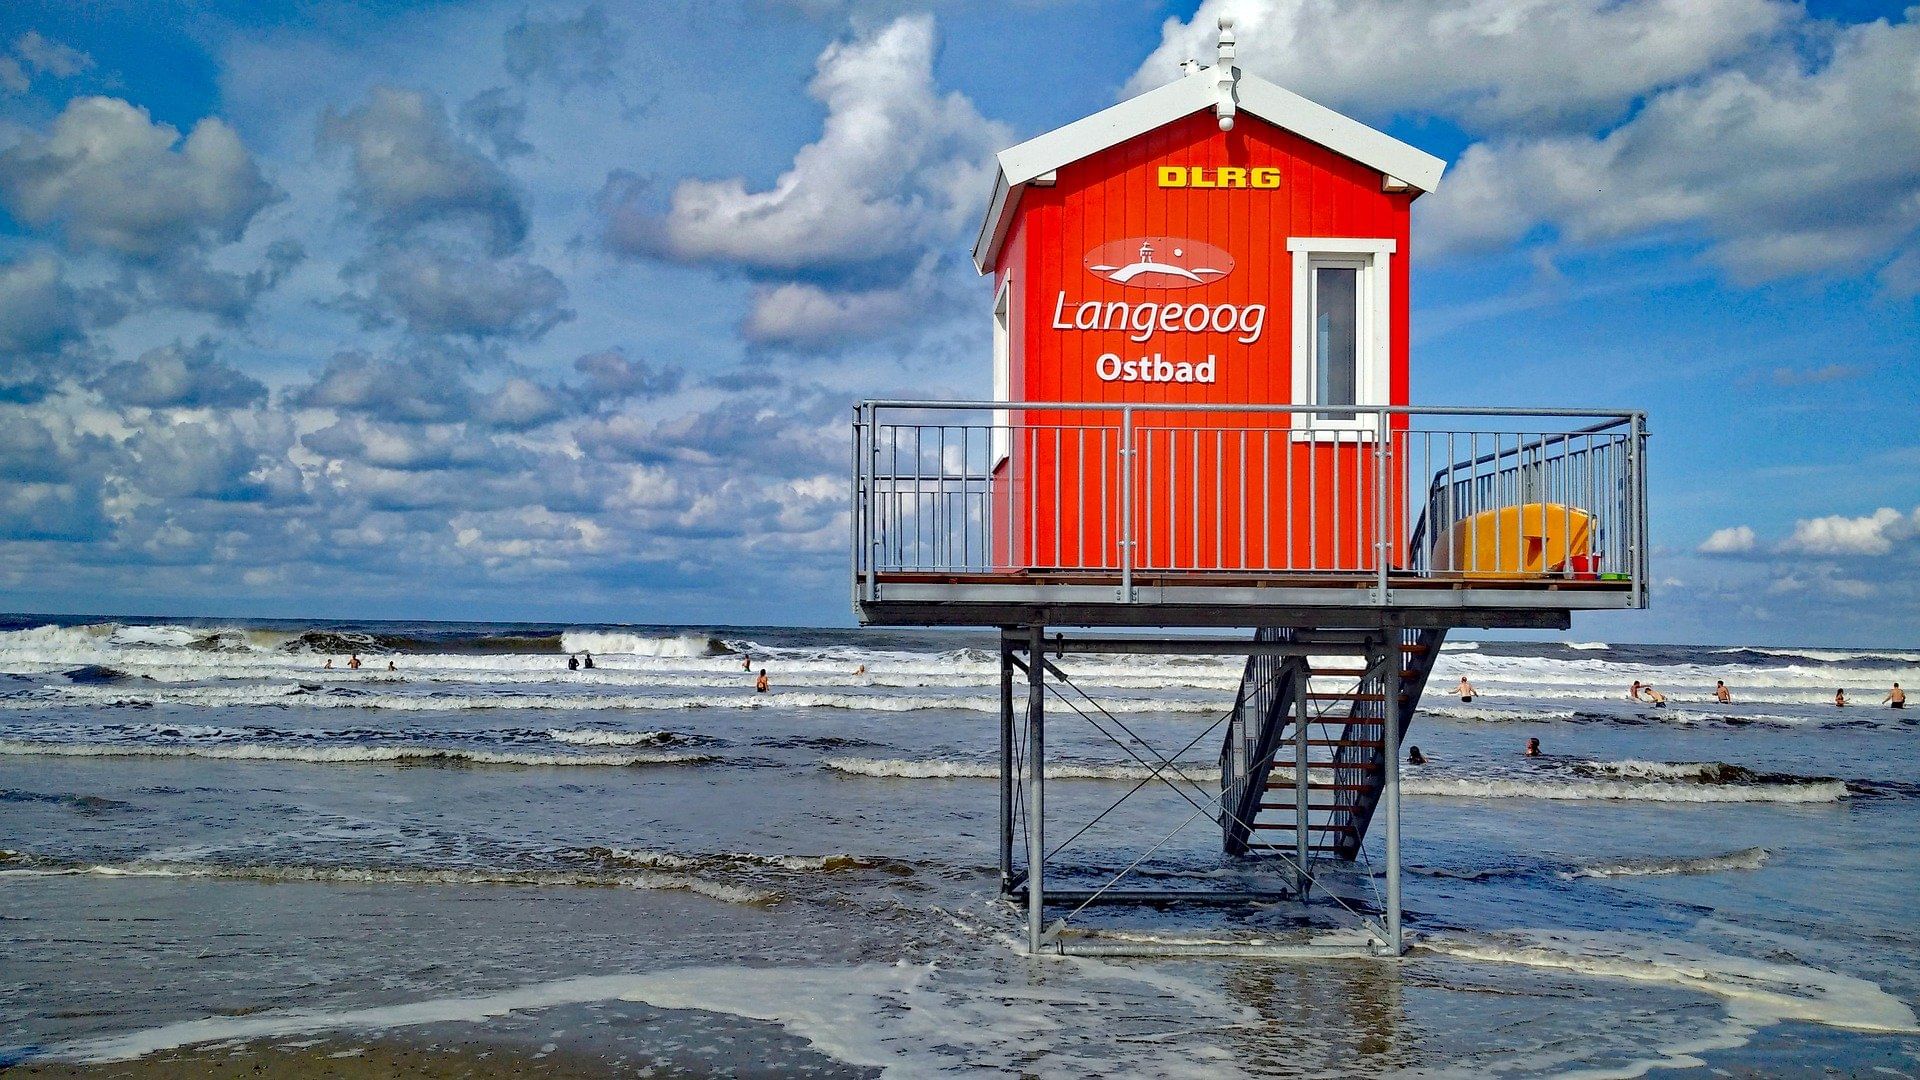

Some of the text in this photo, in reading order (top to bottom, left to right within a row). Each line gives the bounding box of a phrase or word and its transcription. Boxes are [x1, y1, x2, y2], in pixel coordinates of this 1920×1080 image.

[1157, 166, 1281, 189] DLRG
[1052, 290, 1266, 343] Langeoog
[1096, 353, 1216, 383] Ostbad
